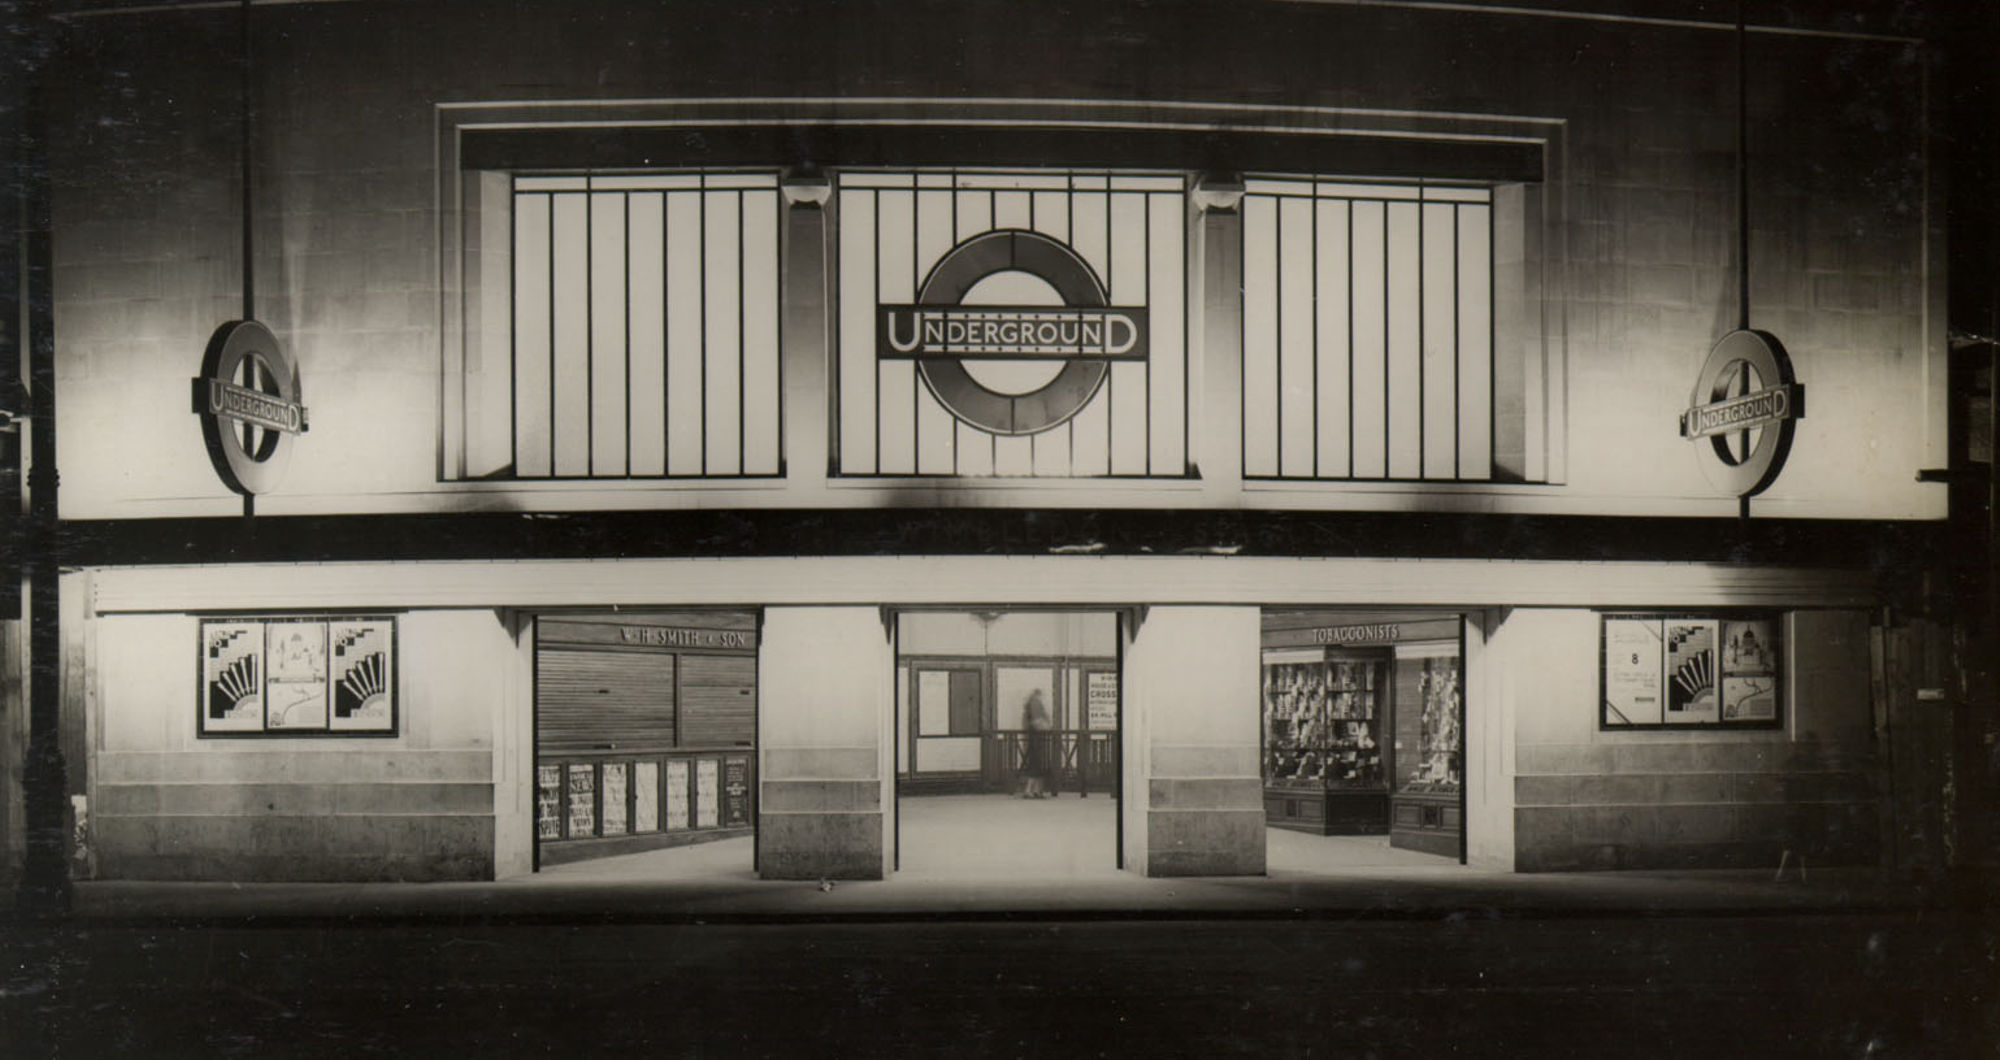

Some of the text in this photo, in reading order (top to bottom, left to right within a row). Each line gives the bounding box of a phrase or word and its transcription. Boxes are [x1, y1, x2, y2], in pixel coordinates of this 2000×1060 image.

[888, 311, 1137, 354] UNDERGROUND
[211, 382, 300, 432] UNDERGROUND
[1688, 390, 1786, 437] UNDERGROUND
[658, 629, 699, 646] SMITH
[719, 631, 745, 648] SON
[1312, 624, 1400, 643] TOBACCONISTS
